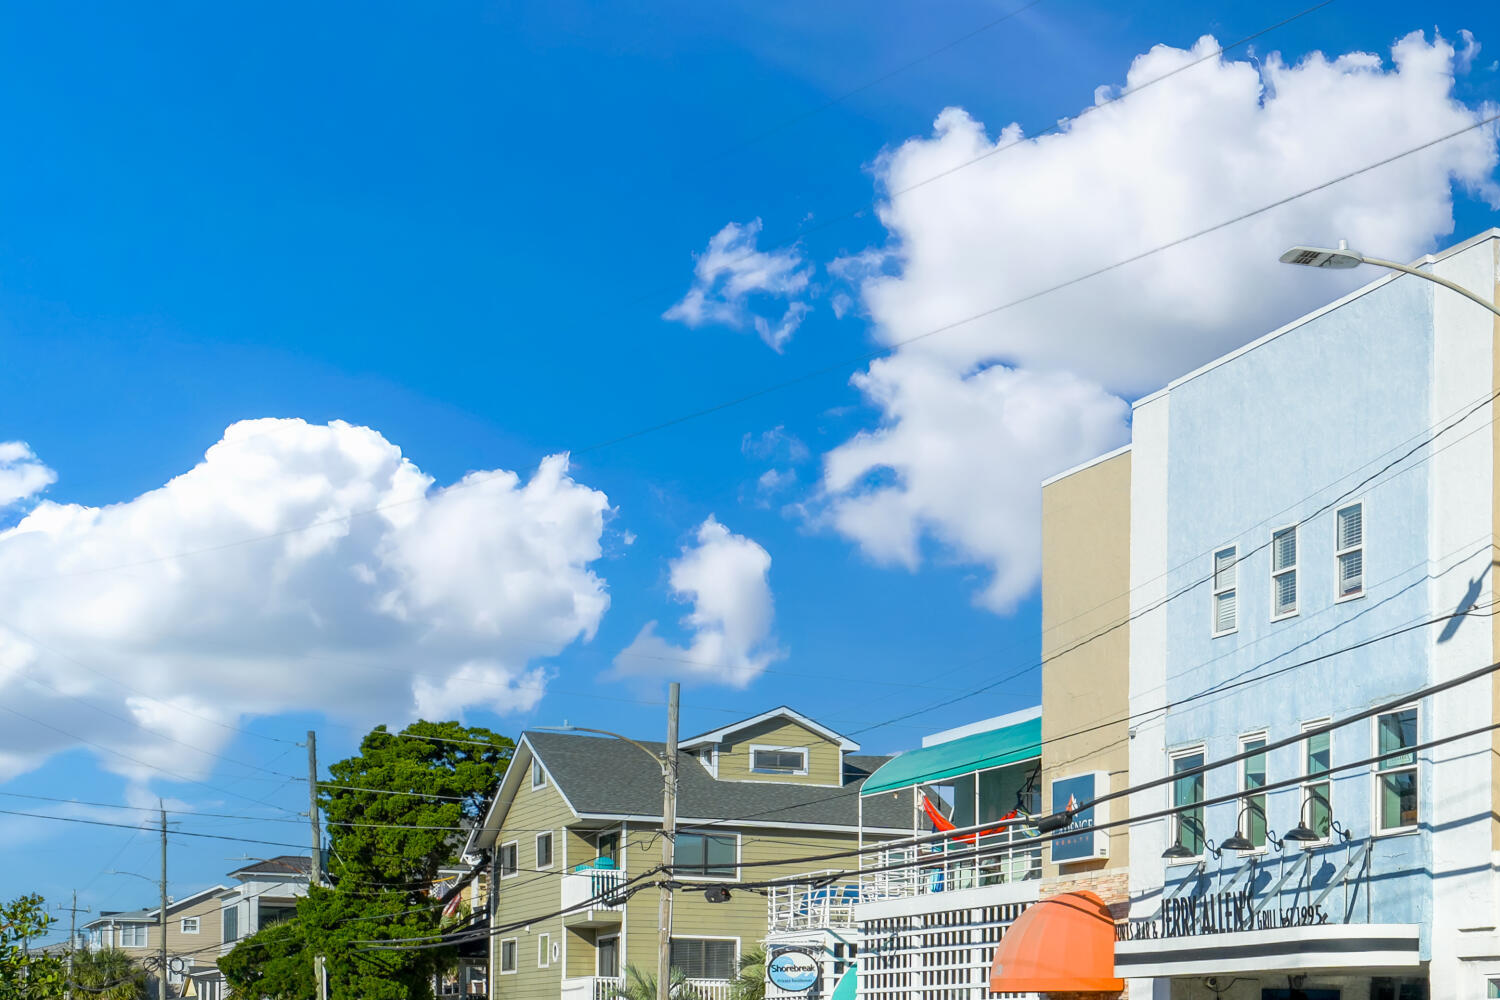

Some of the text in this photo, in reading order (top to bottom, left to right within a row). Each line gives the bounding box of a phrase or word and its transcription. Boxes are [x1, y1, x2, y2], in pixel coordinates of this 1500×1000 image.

[1135, 921, 1150, 940] BAR
[1152, 920, 1159, 939] &
[1161, 897, 1197, 938] JERRY
[1202, 886, 1255, 935] ALLEN'S
[1256, 909, 1276, 930] GRILL
[771, 964, 815, 972] Shorebreak
